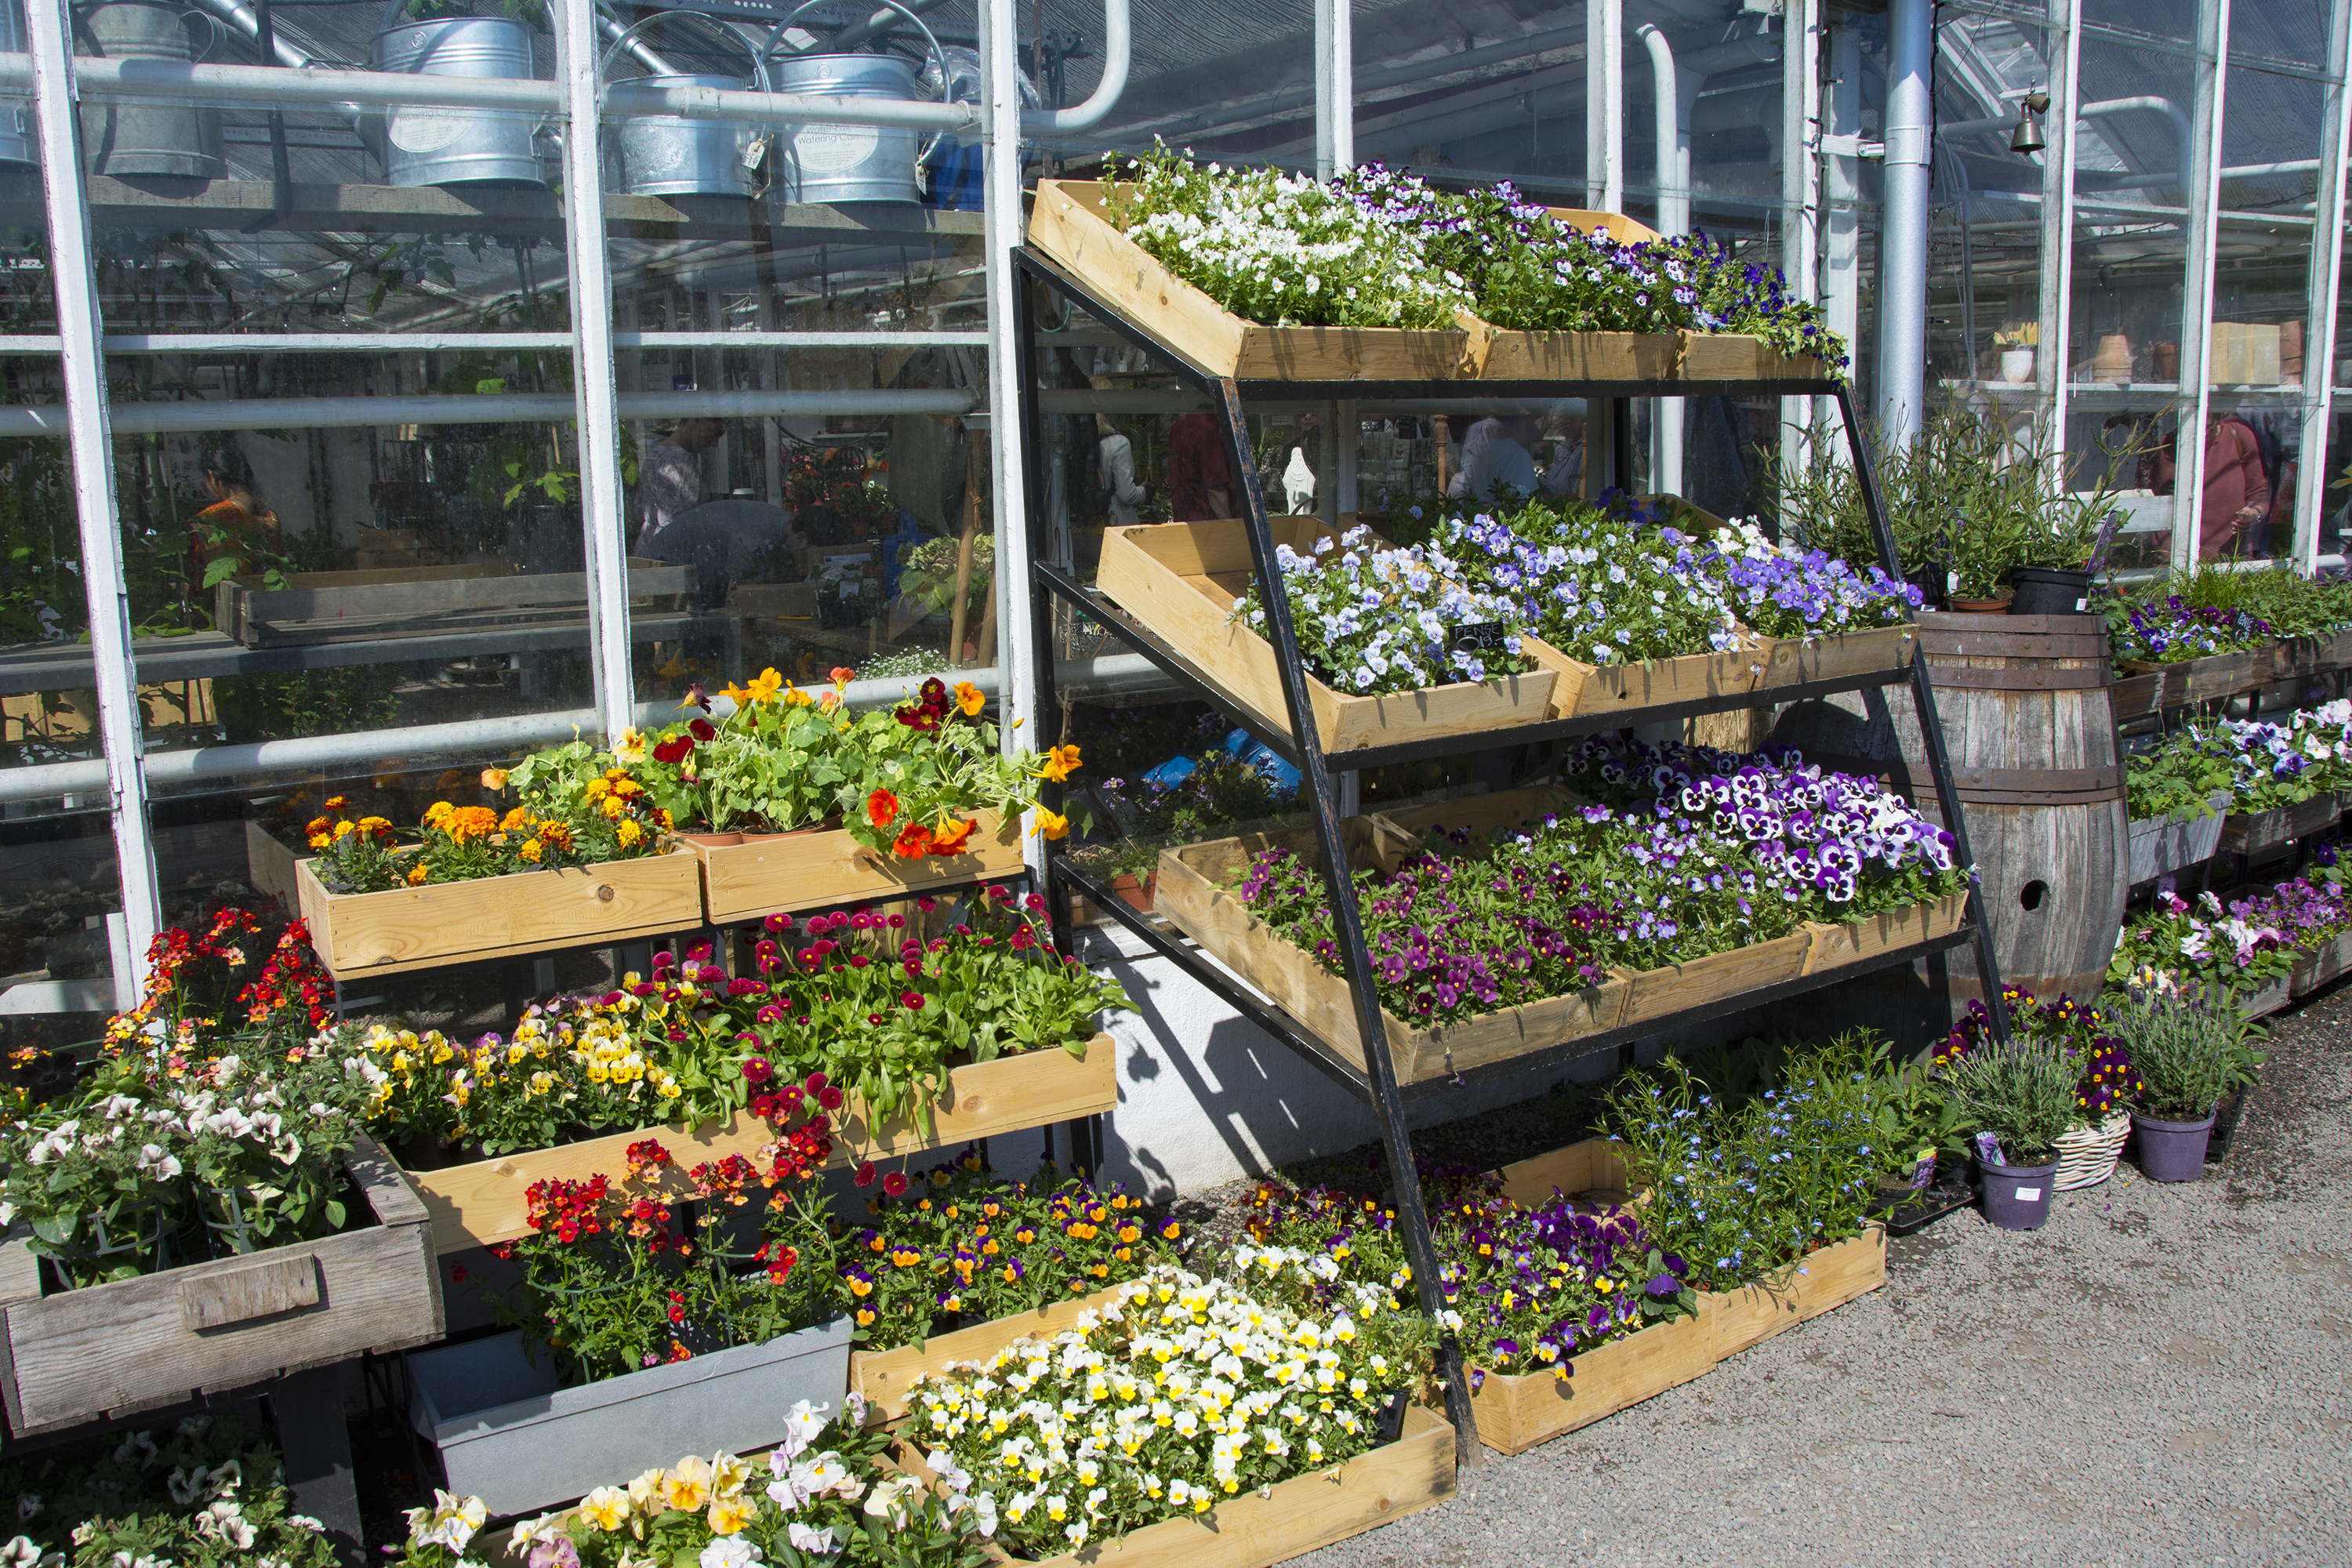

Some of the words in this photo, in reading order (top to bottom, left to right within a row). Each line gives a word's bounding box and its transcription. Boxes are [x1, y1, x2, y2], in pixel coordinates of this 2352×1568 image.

[798, 134, 837, 144] Watering
[839, 132, 859, 141] Can
[436, 919, 496, 940] ROSENDALS
